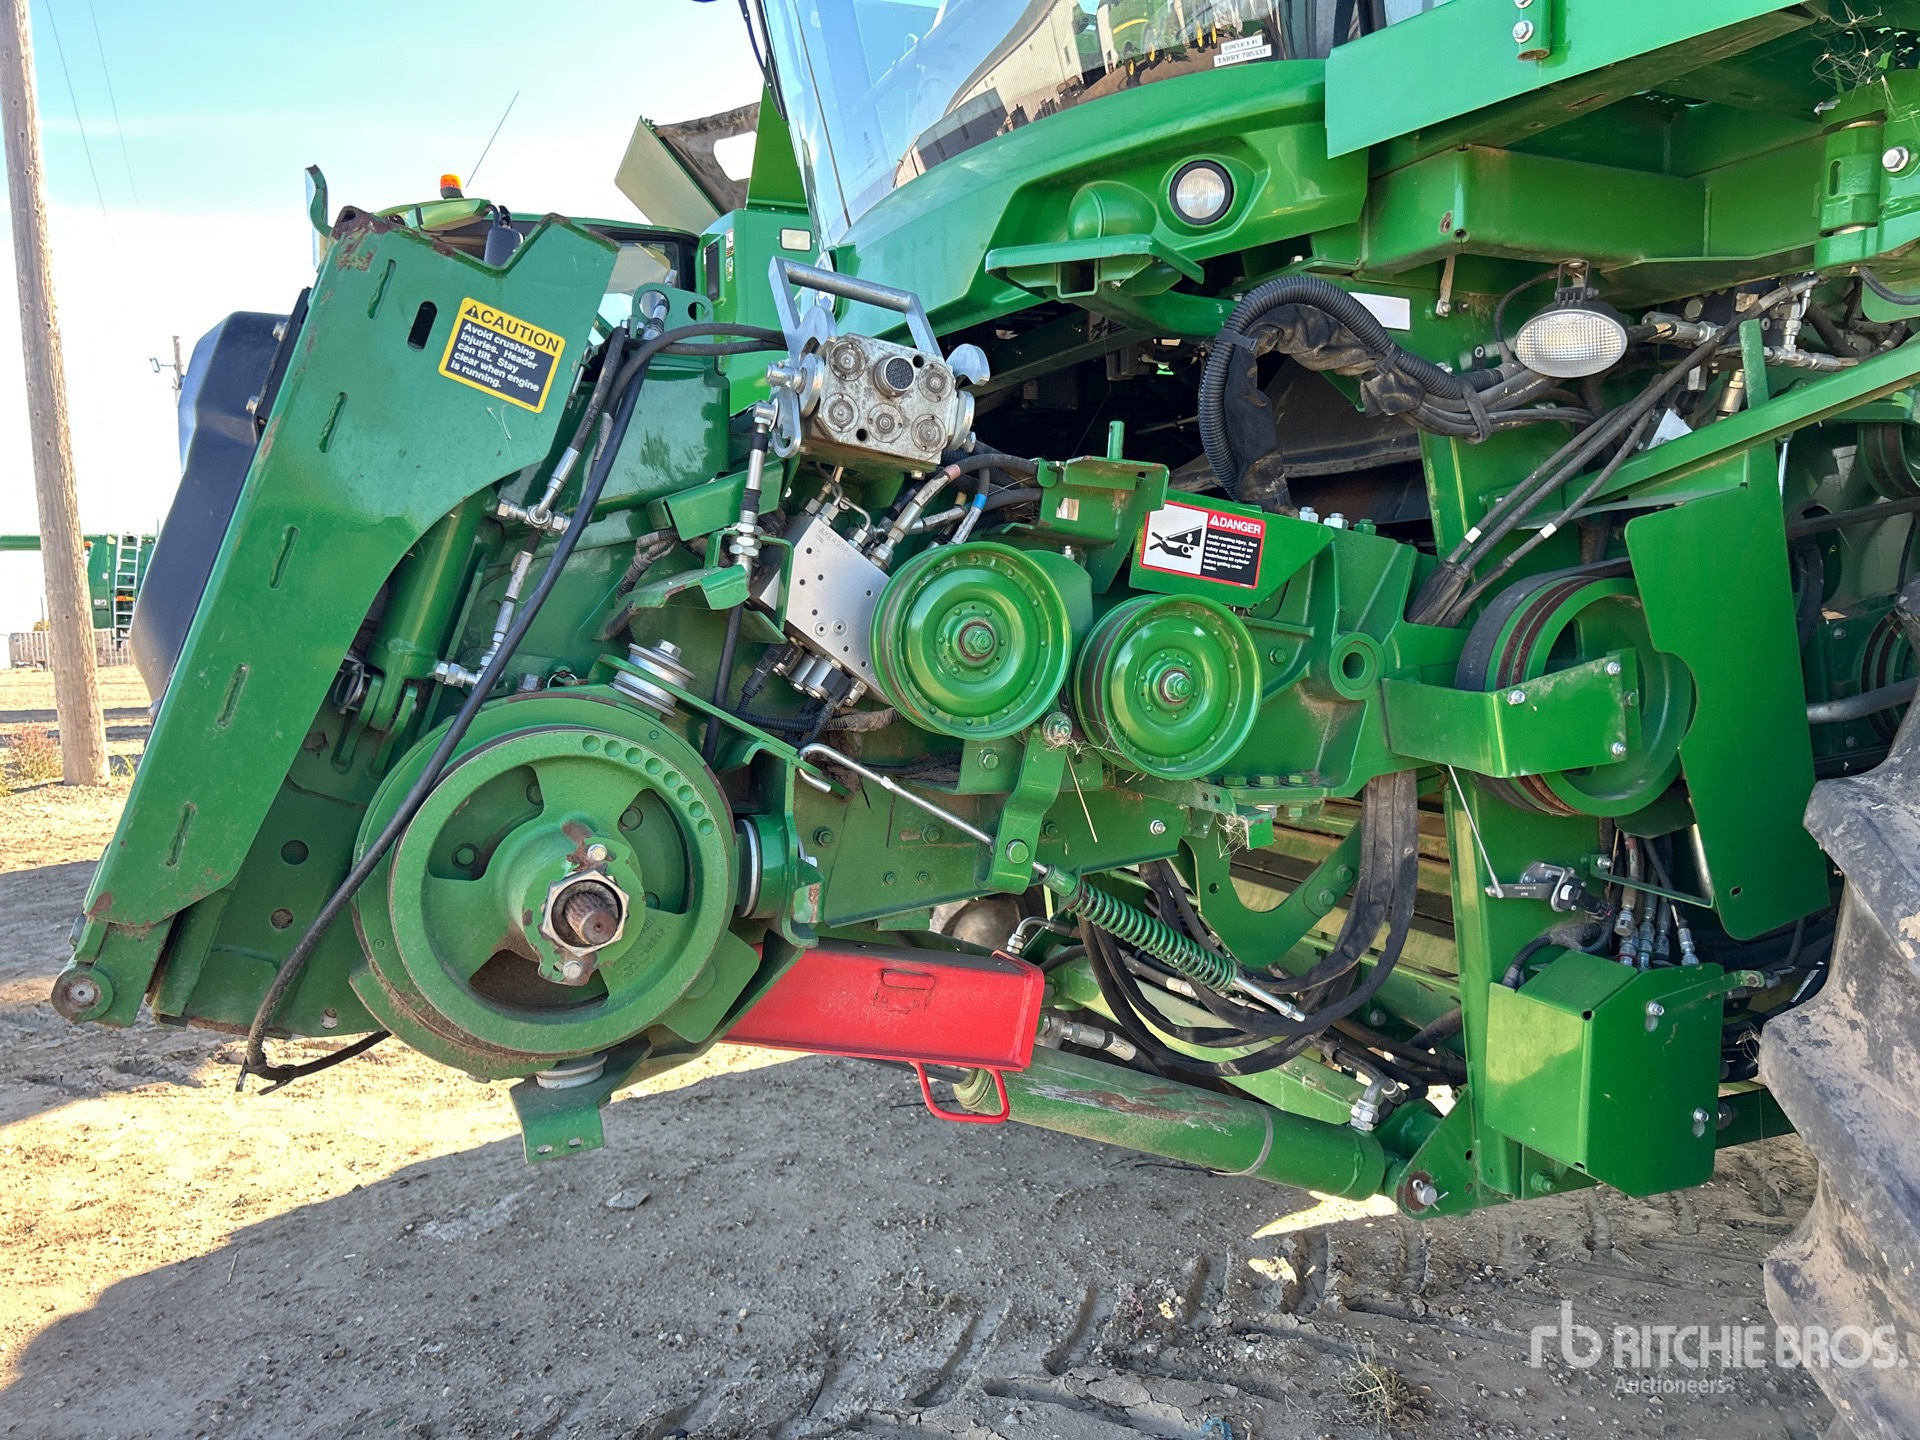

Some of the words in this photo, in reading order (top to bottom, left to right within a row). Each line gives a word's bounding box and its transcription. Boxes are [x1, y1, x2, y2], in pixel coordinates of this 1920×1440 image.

[1217, 53, 1240, 64] TARRY
[1241, 48, 1266, 59] 795337
[1224, 41, 1245, 51] CIRCLE
[464, 322, 493, 341] Avoid
[494, 337, 536, 360] crushing
[481, 310, 559, 352] CAUTION
[458, 343, 475, 355] can
[477, 350, 492, 363] tilt.
[497, 357, 519, 374] Stay
[461, 332, 499, 354] injuries.
[503, 349, 538, 370] Header
[451, 360, 460, 370] is
[462, 364, 501, 388] running.
[454, 352, 479, 367] clear
[480, 363, 506, 378] when
[507, 373, 540, 392] engine
[1220, 517, 1261, 535] DANGER
